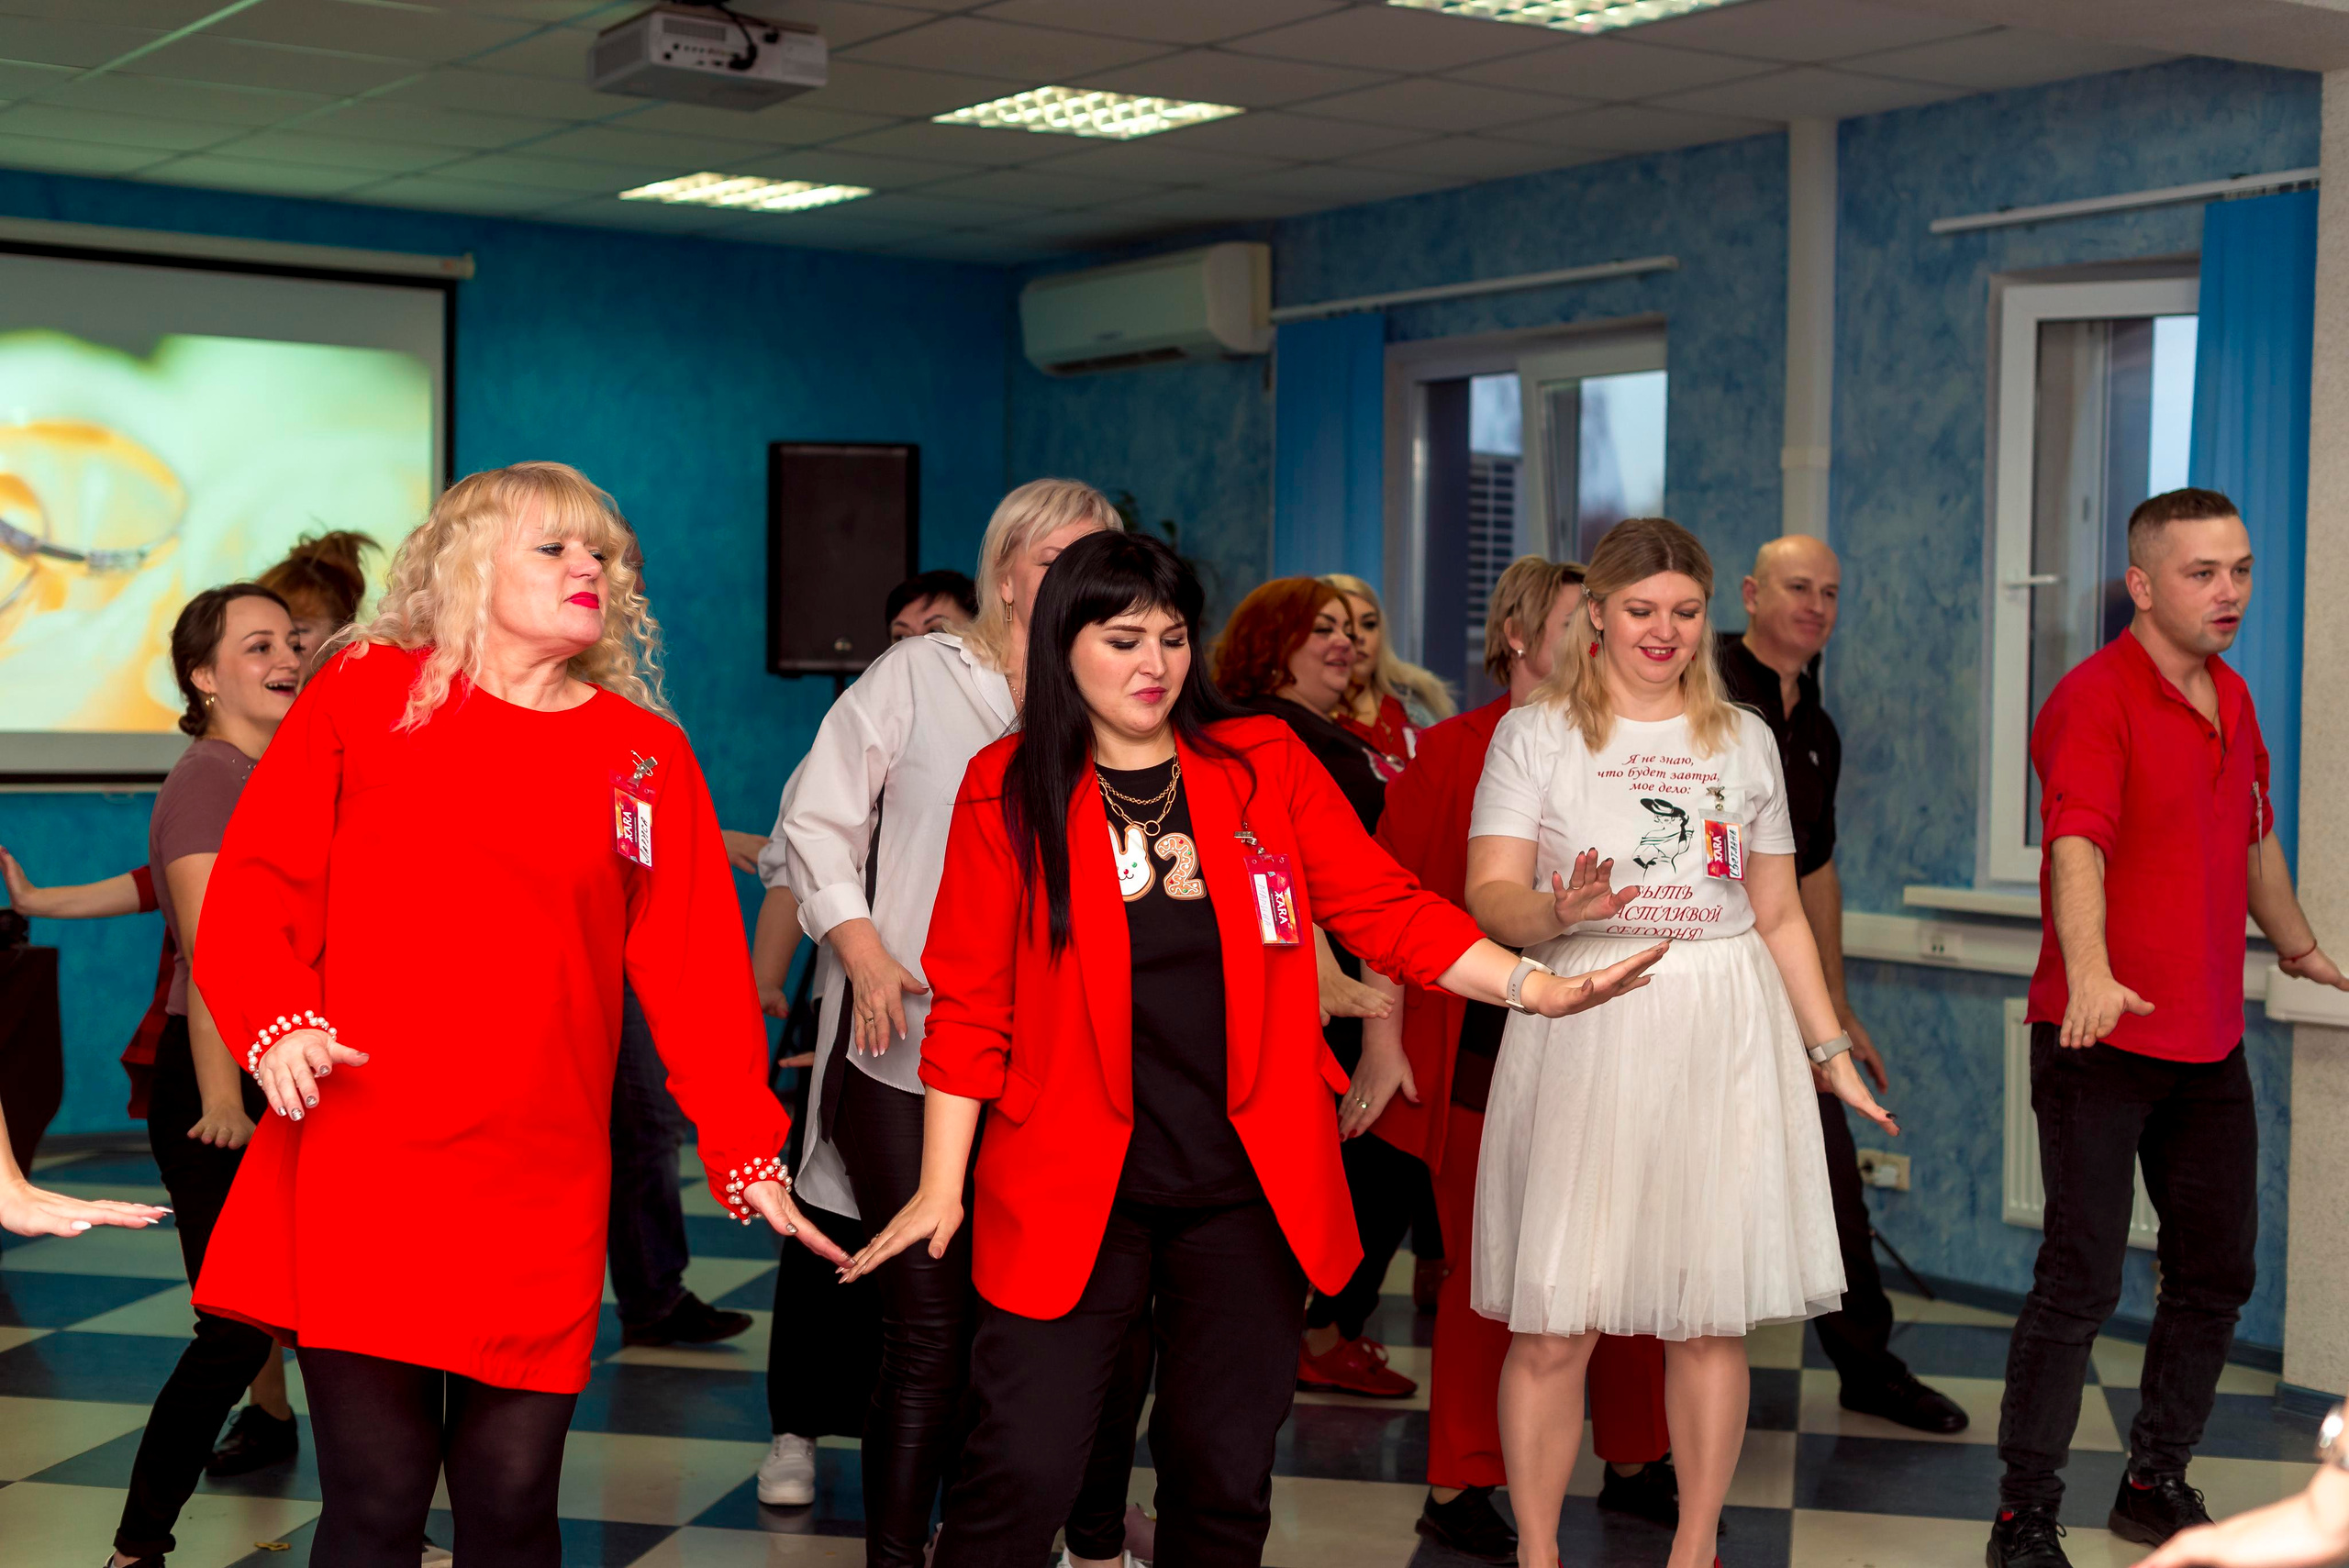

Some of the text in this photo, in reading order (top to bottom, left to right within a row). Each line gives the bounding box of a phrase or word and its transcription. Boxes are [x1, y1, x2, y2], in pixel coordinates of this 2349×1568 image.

[1622, 754, 1694, 767] Я не знаю,
[1598, 766, 1720, 784] что будет завтра,
[1630, 782, 1691, 795] мое дело:
[1154, 832, 1207, 900] 2
[1608, 905, 1723, 923] АСТЛИВОЙ
